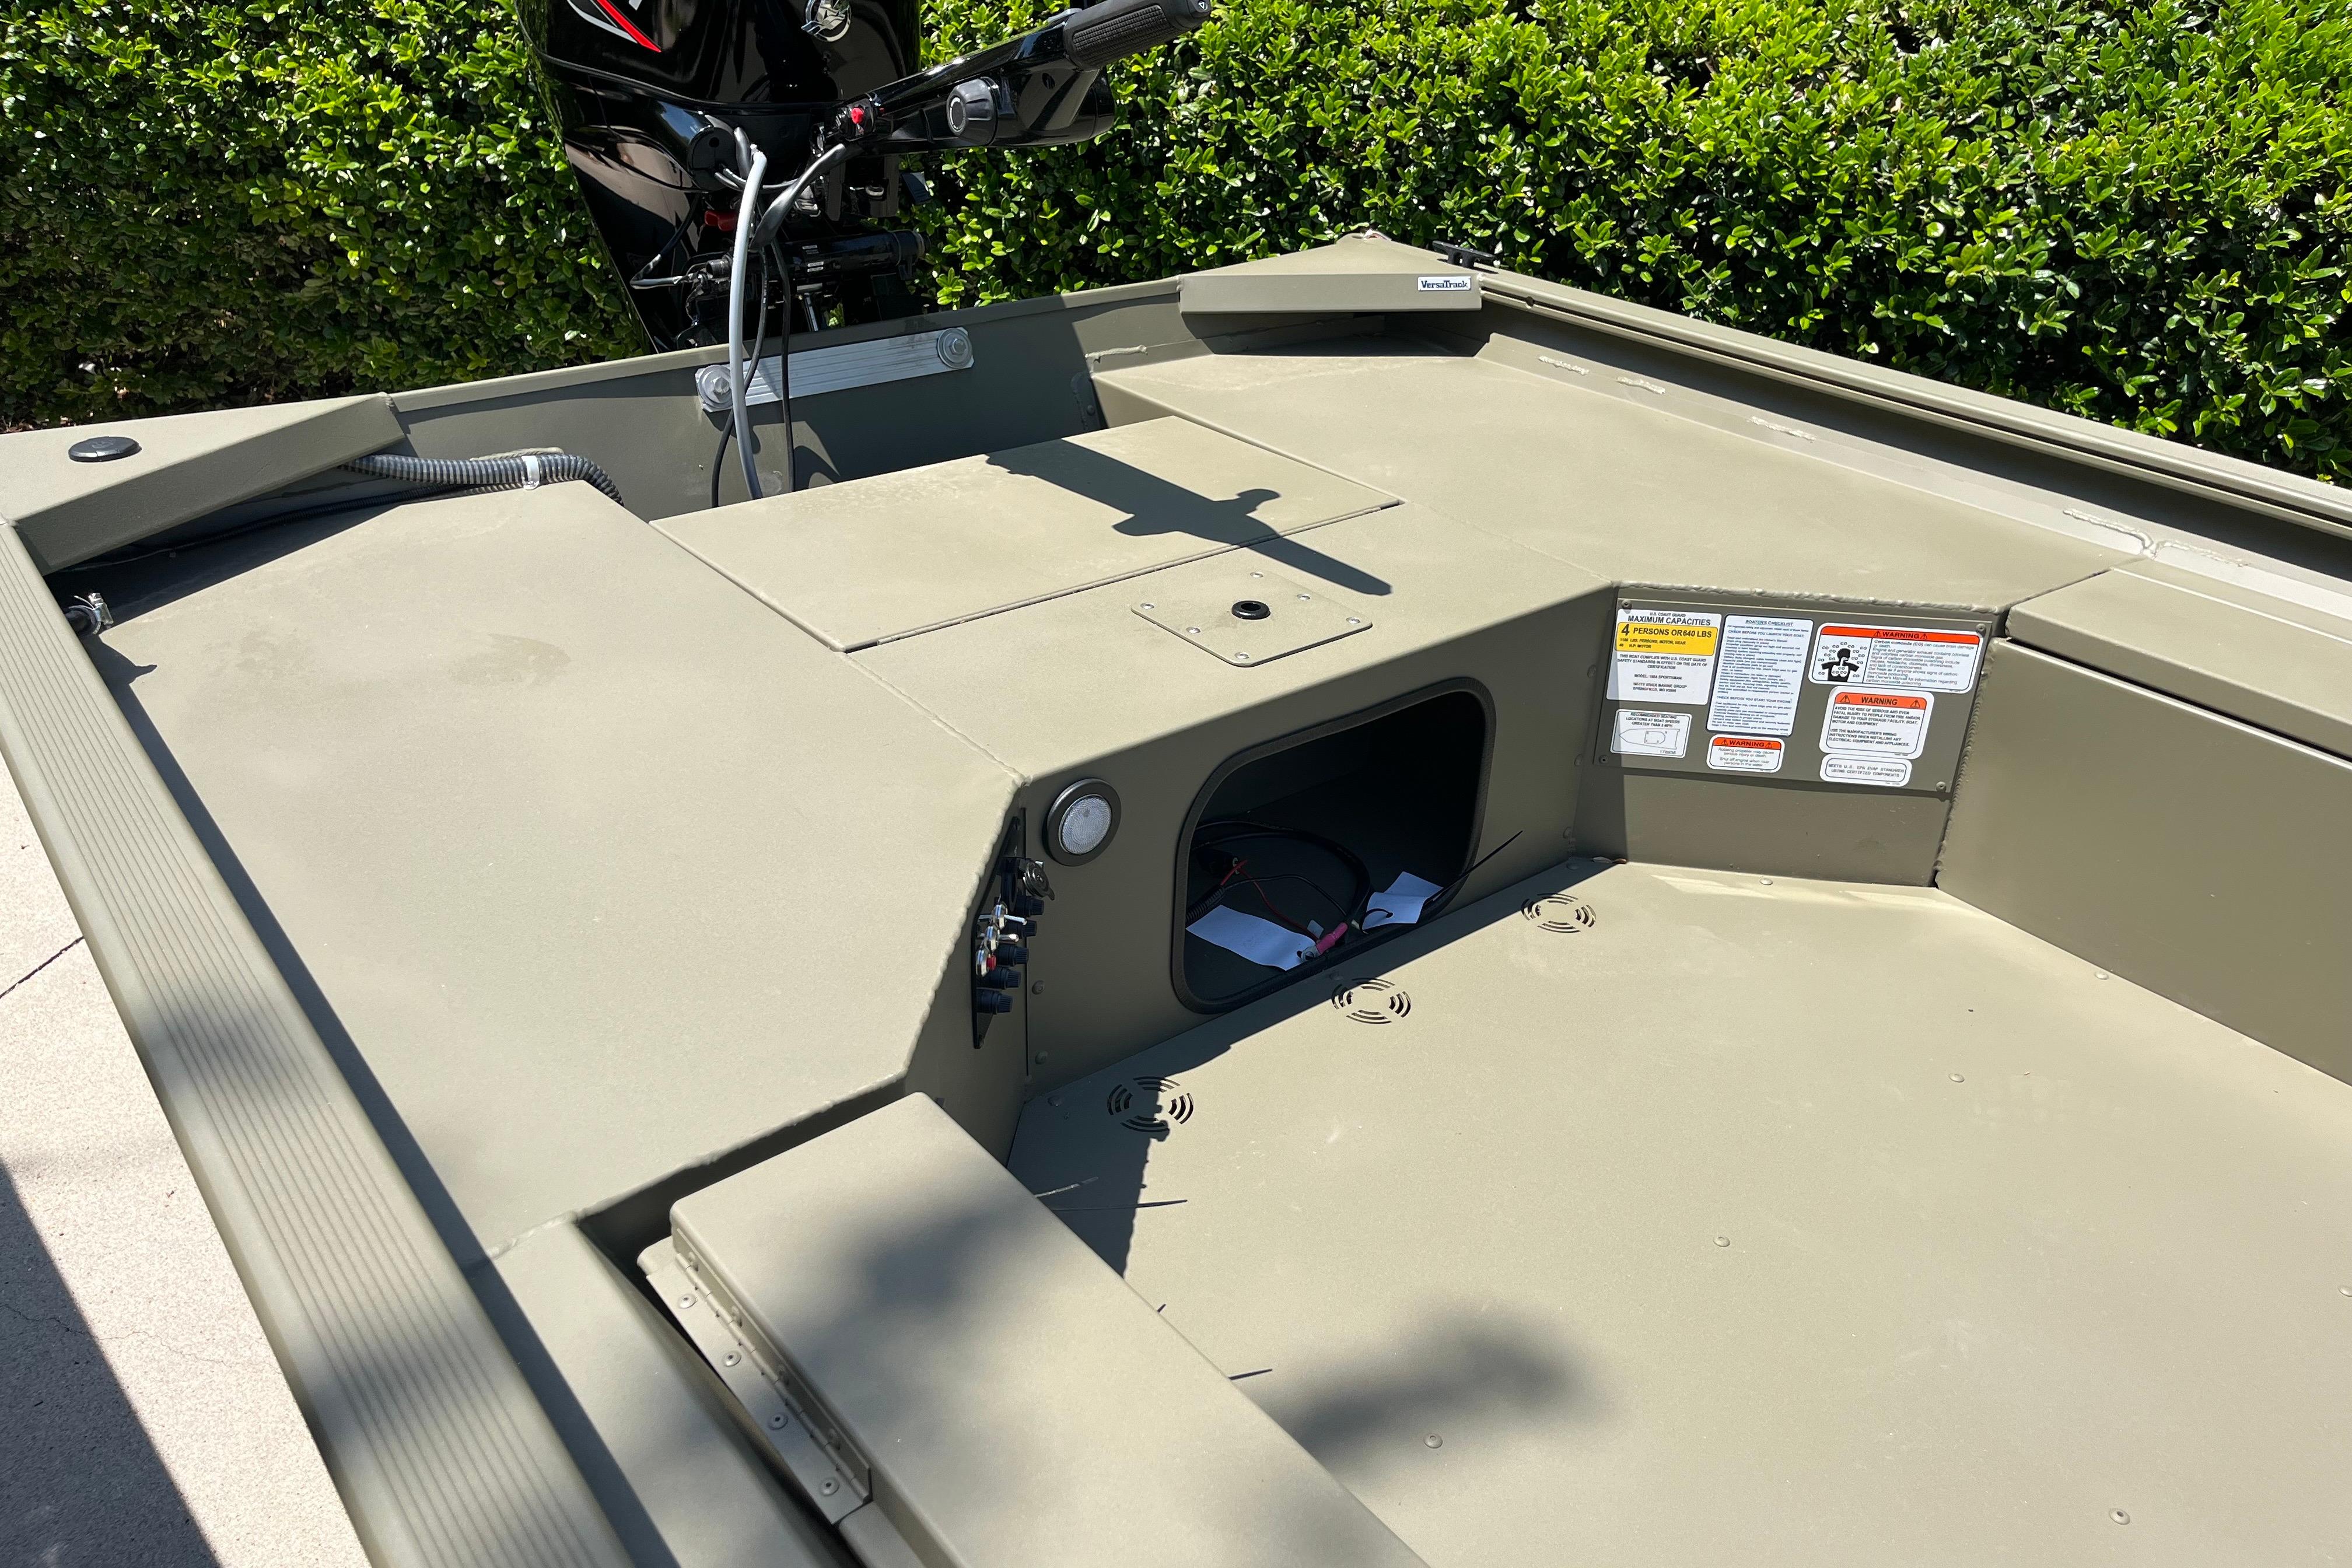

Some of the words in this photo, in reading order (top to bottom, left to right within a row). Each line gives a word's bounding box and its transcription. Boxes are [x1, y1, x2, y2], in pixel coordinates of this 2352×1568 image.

[1421, 280, 1468, 288] VersaTrack
[1666, 617, 1711, 626] CAPACITIES
[1621, 624, 1630, 636] 4
[1633, 627, 1669, 636] PERSONS
[1861, 696, 1898, 705] WARNING
